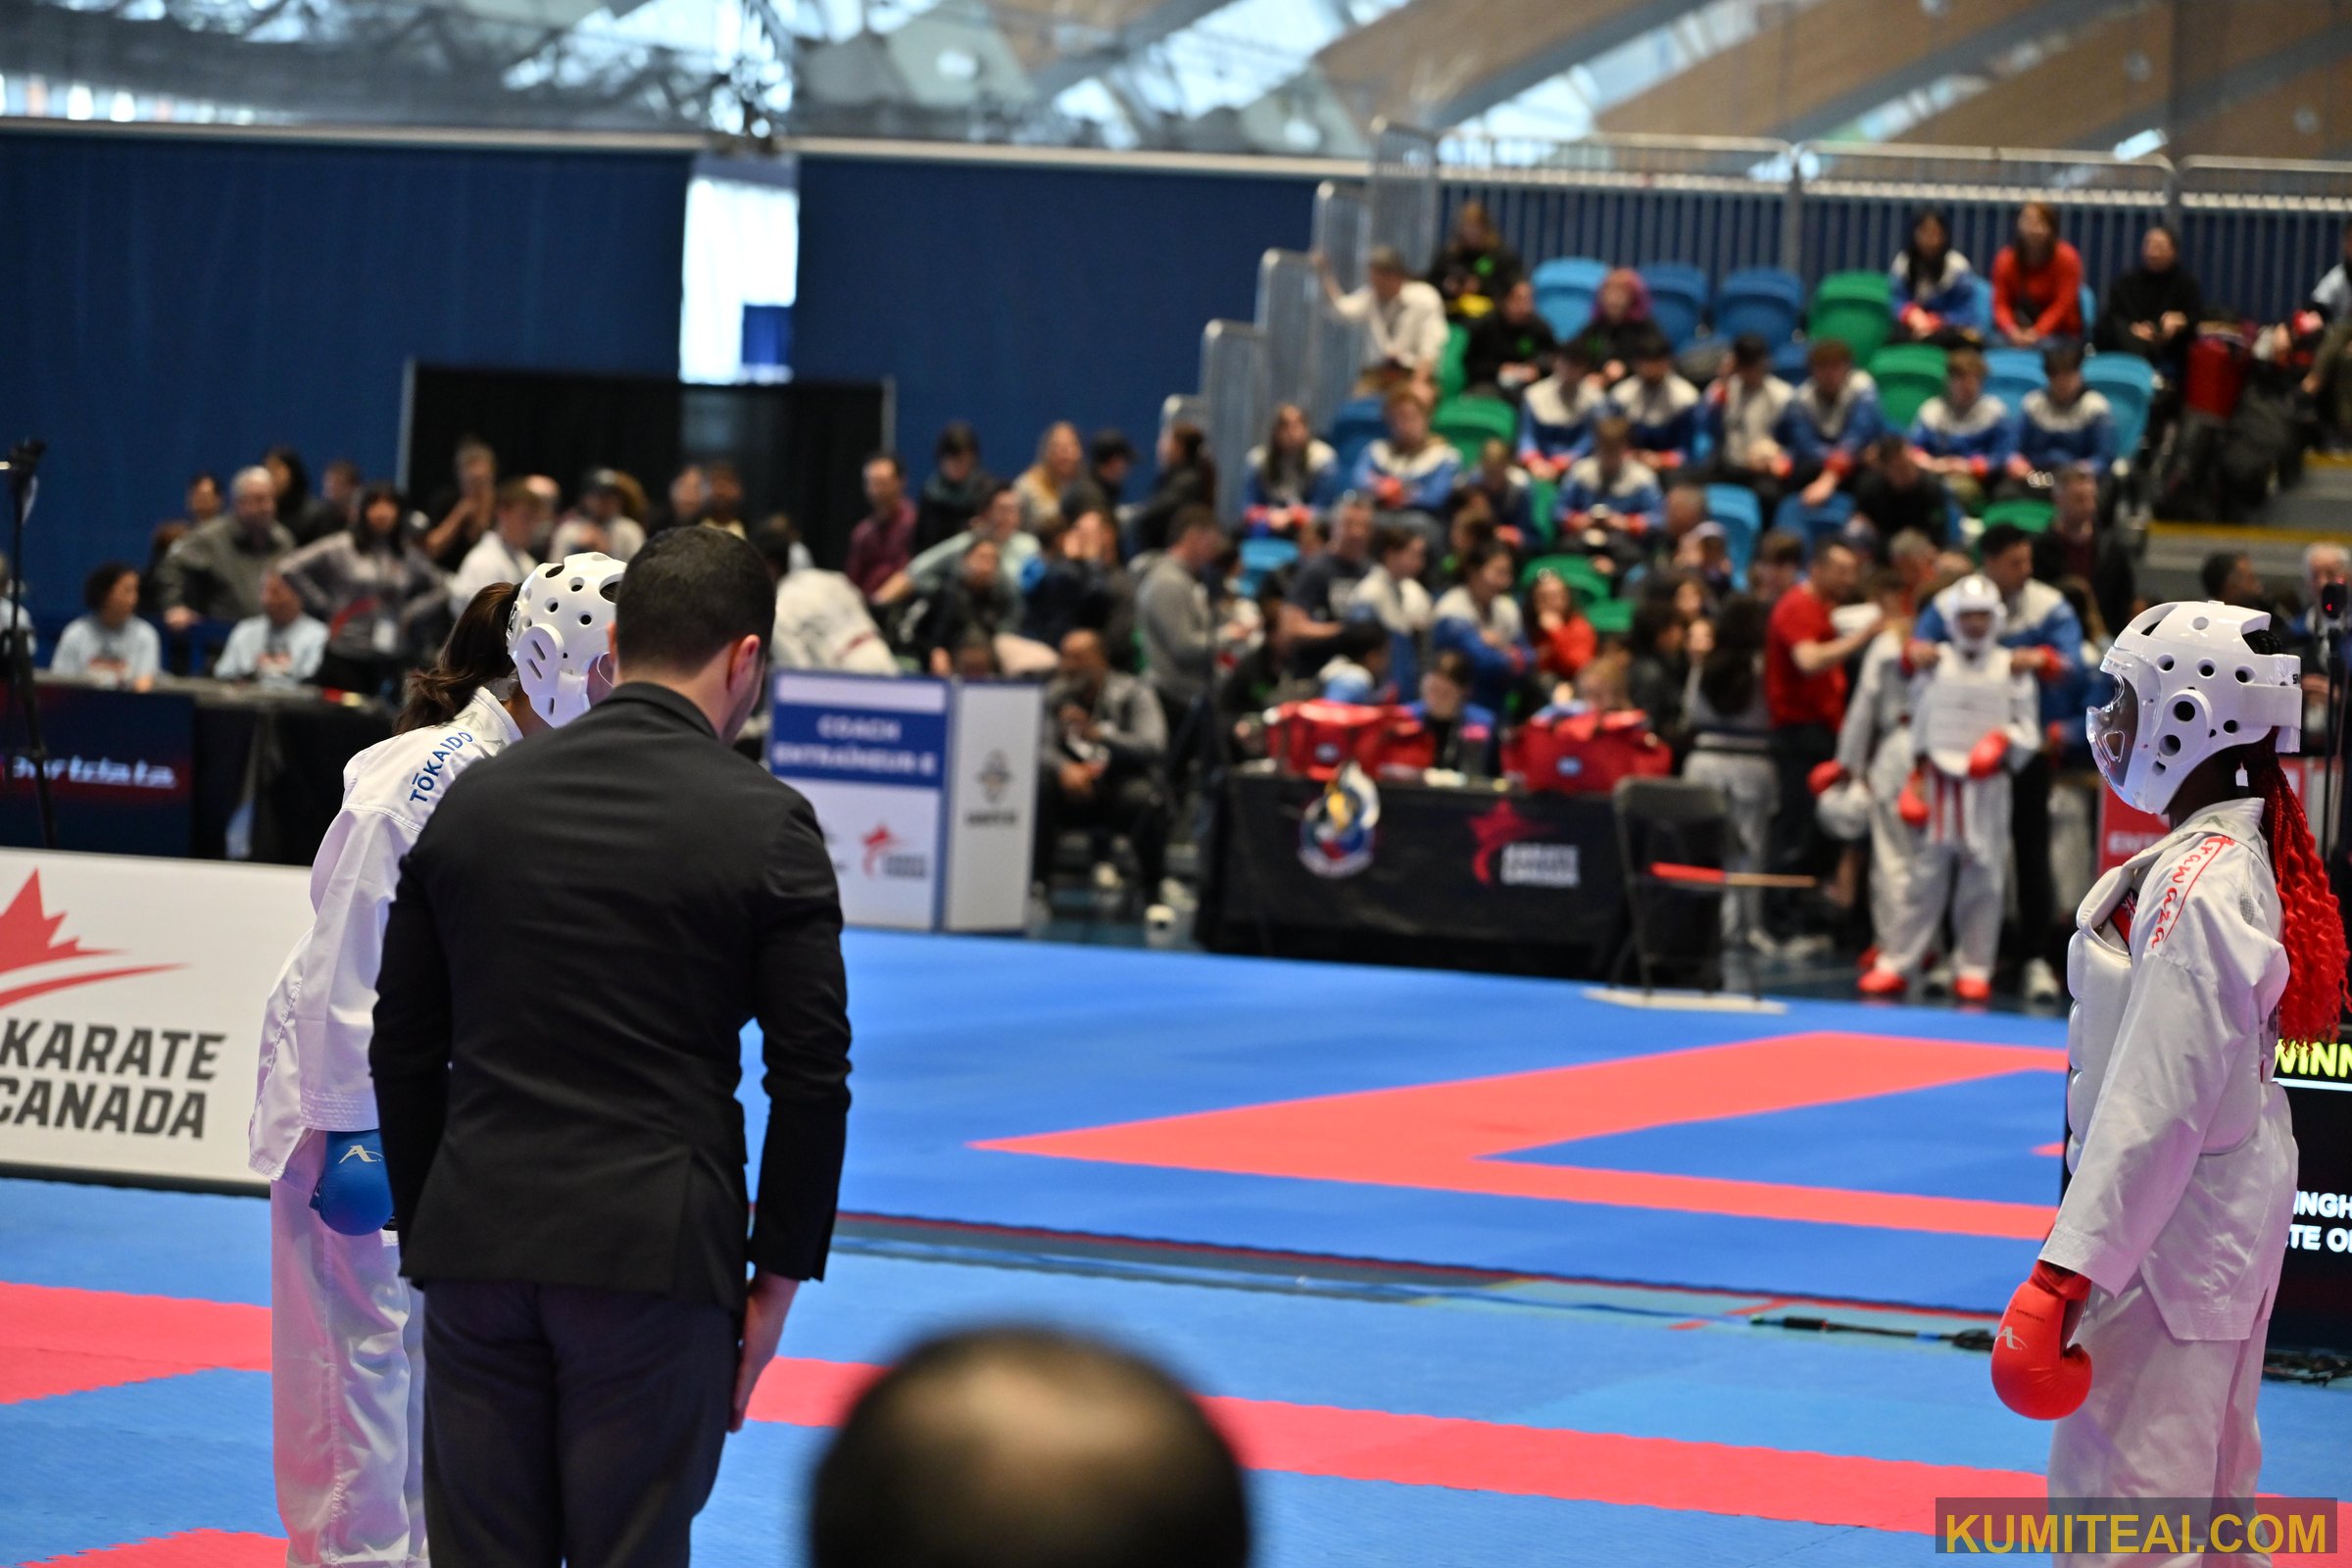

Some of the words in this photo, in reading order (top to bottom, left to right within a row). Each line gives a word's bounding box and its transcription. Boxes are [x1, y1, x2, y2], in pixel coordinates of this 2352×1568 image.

[0, 1019, 226, 1080] KARATE
[0, 1076, 206, 1140] CANADA
[2287, 1224, 2322, 1250] TE
[2326, 1227, 2352, 1254] O
